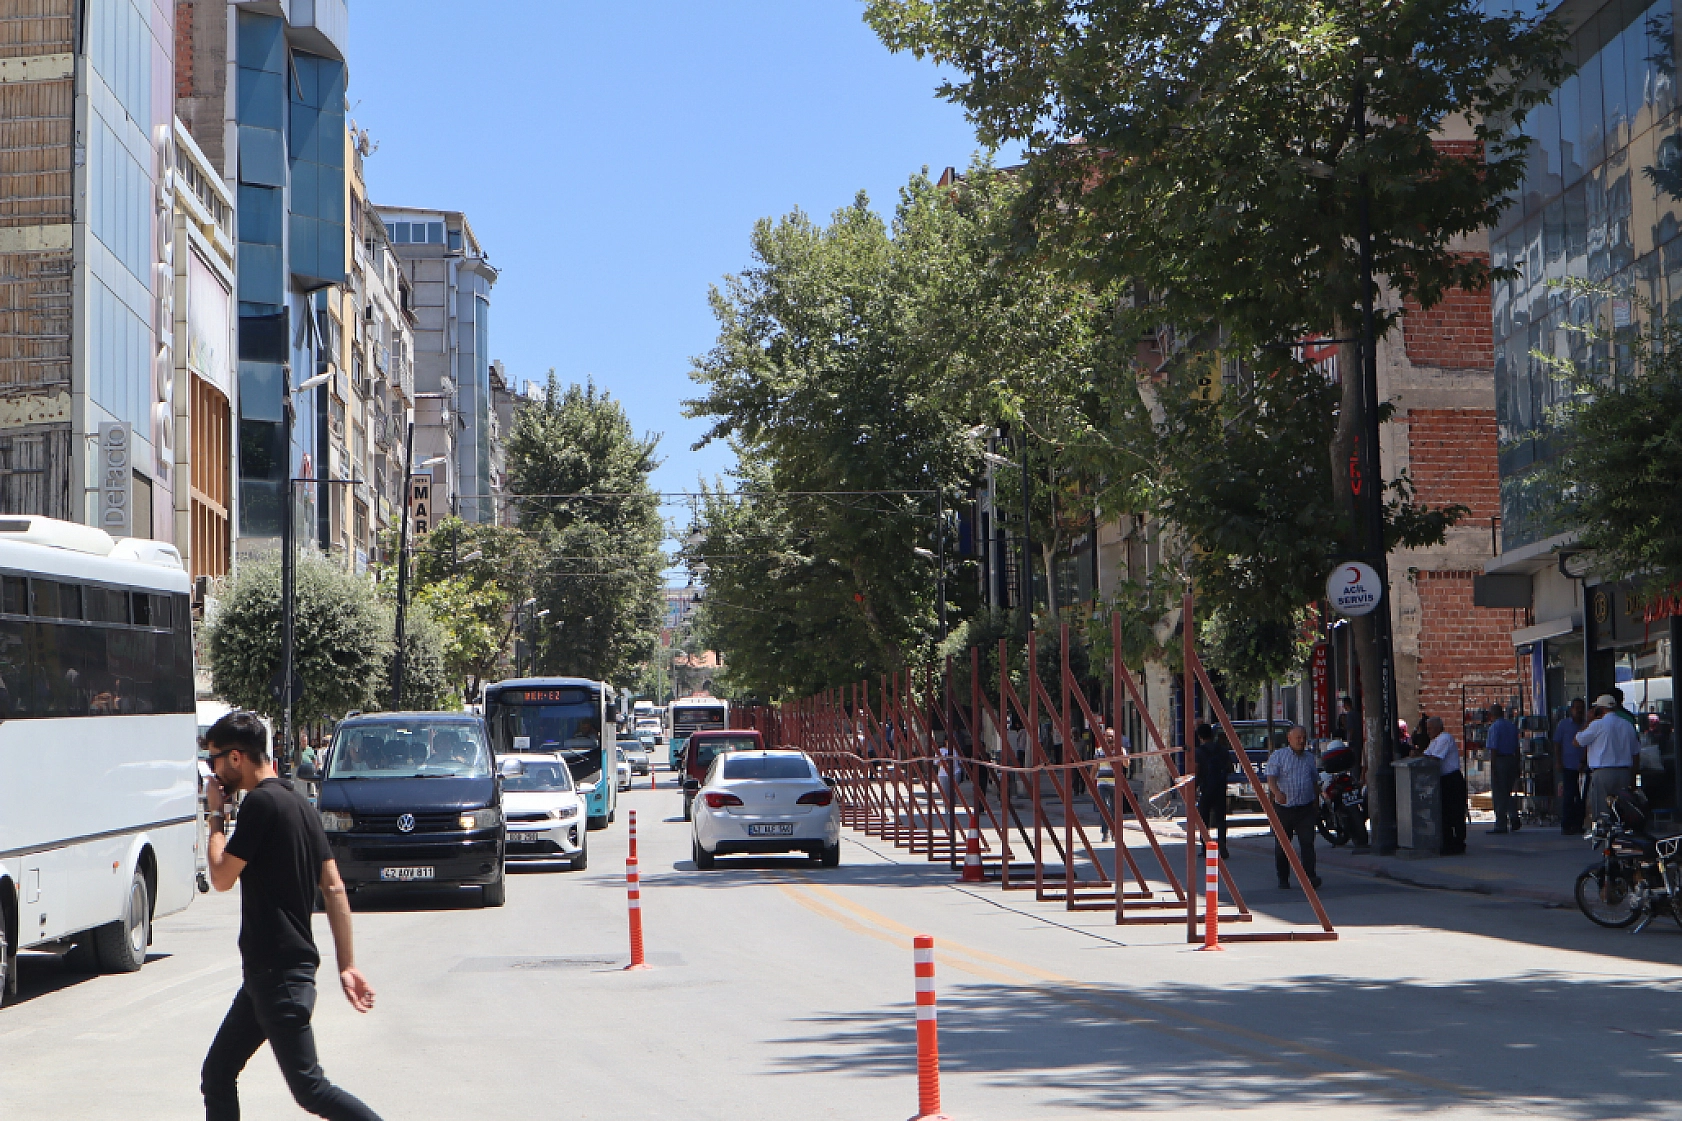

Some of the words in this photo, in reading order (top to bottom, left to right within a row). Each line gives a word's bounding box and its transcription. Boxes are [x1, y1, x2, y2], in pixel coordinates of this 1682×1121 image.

[104, 424, 126, 526] DeFacto
[1343, 584, 1367, 595] ACİL
[1338, 593, 1374, 605] SERVİS
